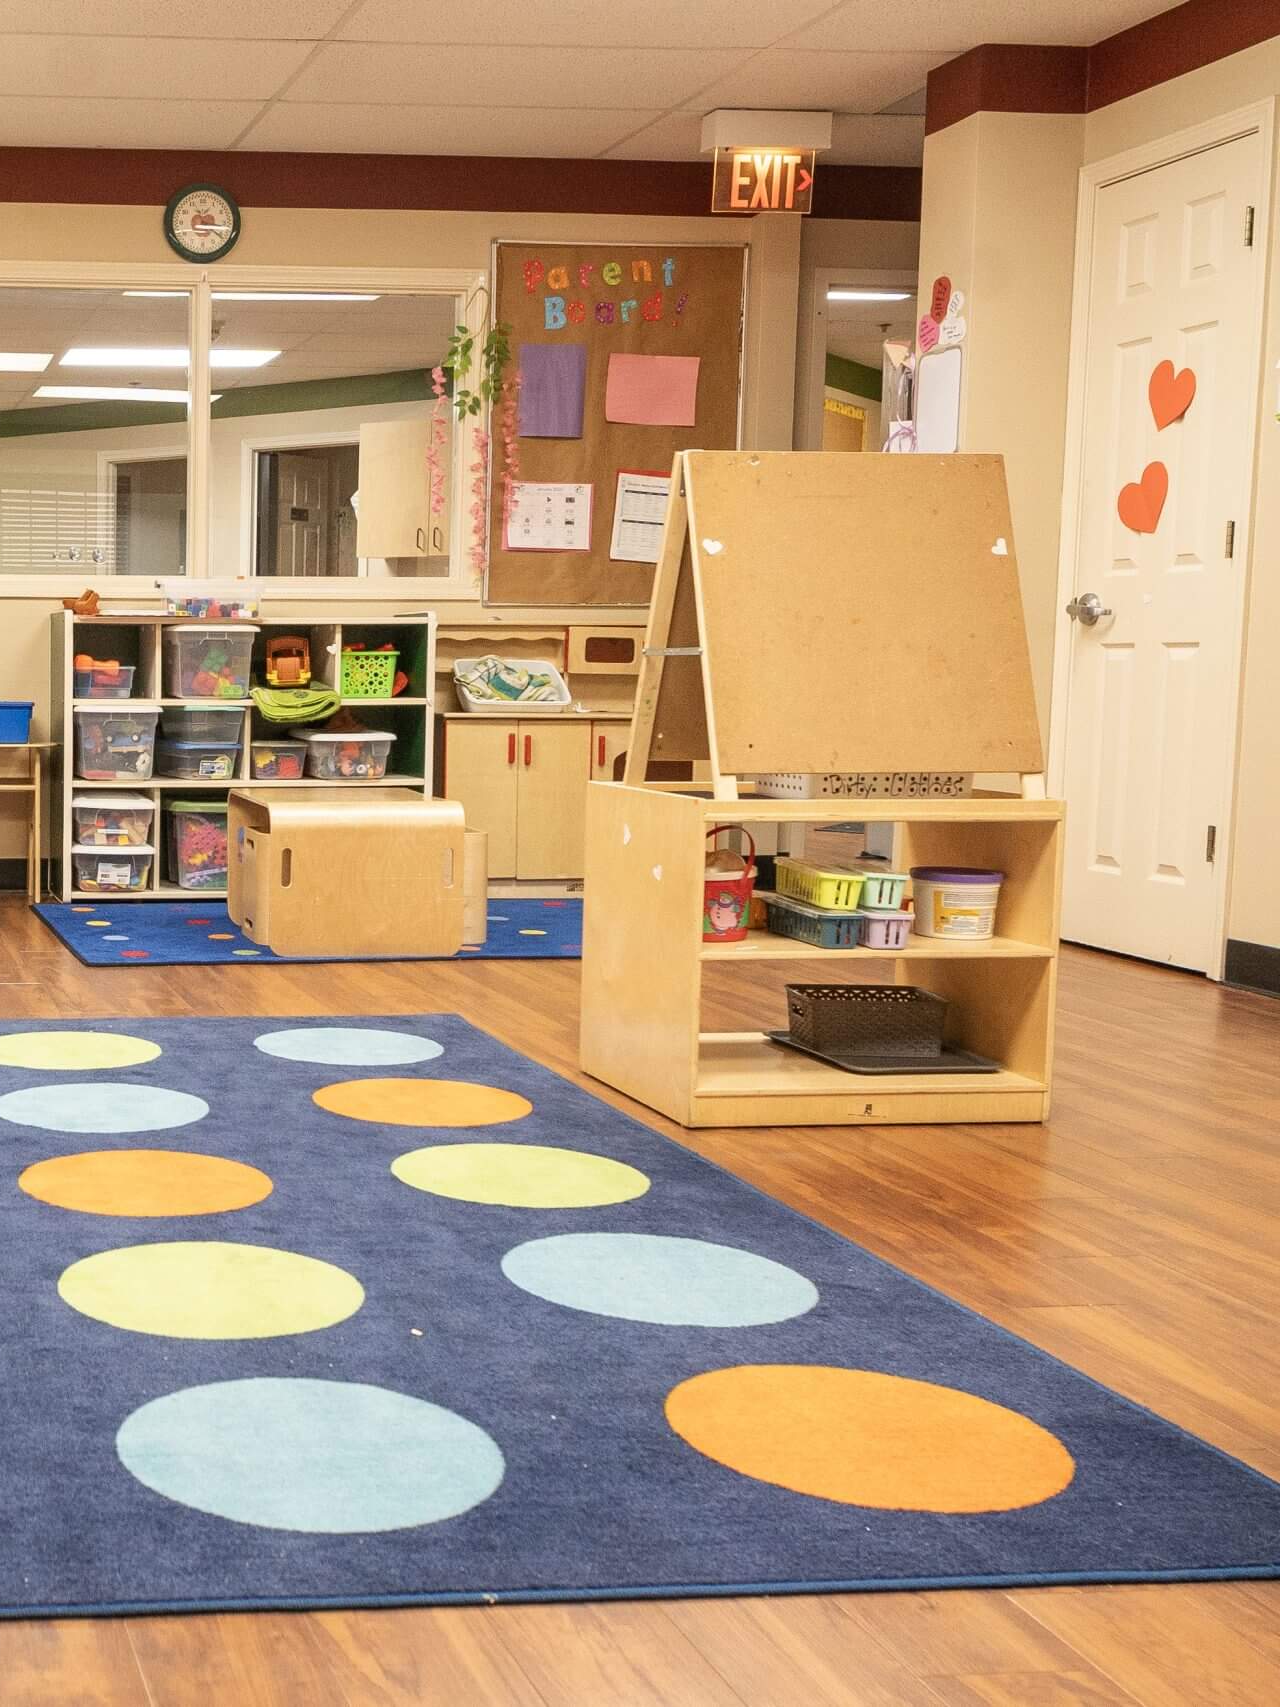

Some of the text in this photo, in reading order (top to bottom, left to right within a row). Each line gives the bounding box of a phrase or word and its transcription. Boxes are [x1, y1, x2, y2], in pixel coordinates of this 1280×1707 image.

[730, 153, 801, 209] EXIT
[522, 257, 676, 294] Parent
[544, 289, 688, 330] Board!
